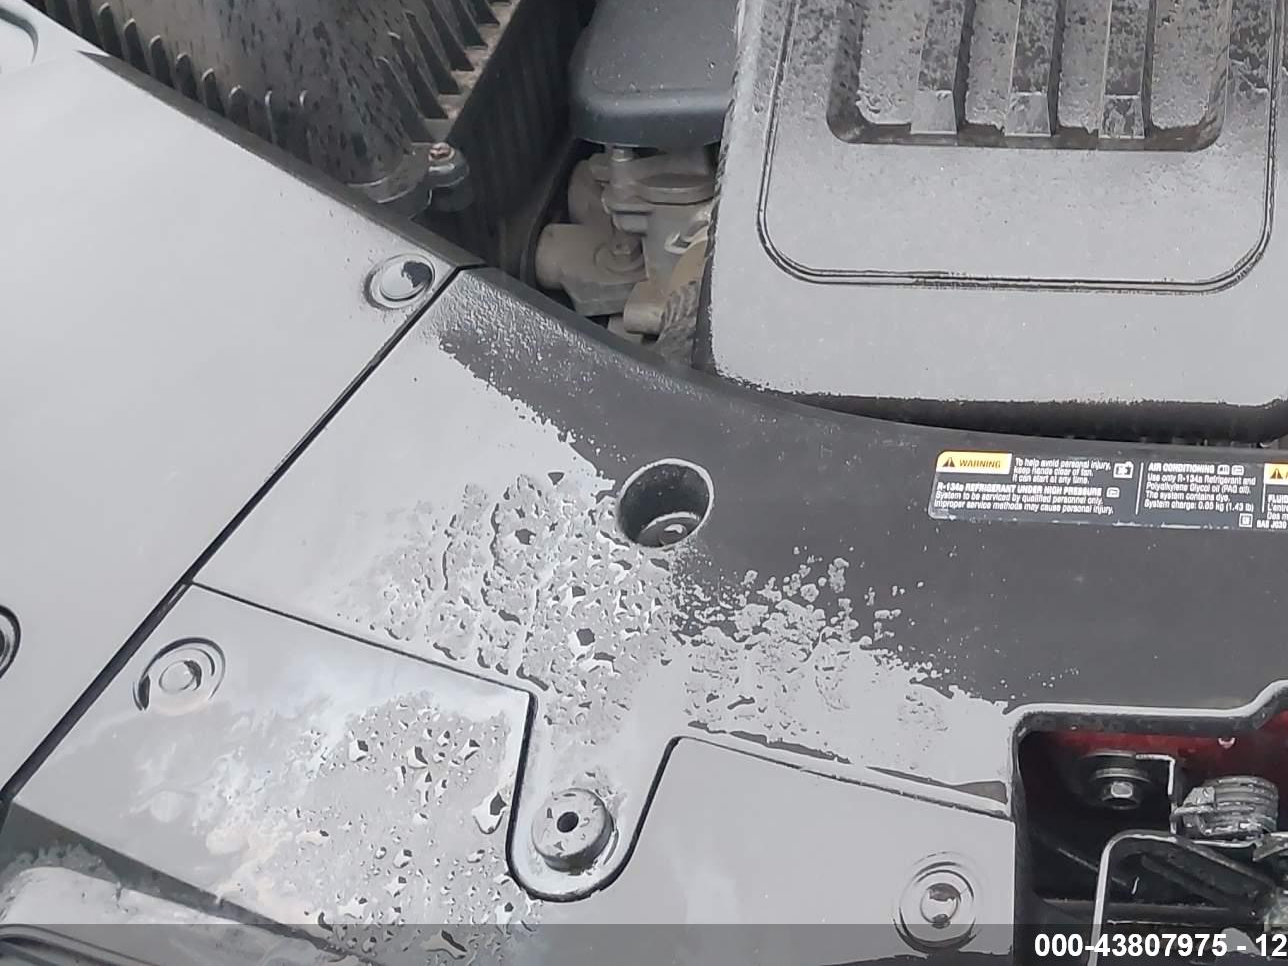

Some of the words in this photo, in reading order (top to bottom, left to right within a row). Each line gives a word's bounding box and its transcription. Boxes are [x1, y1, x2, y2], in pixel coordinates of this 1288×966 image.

[959, 459, 1000, 469] WARNING
[1148, 463, 1161, 472] AIR
[1163, 463, 1215, 473] CONDITIONING
[1147, 473, 1160, 481] Use
[1162, 474, 1176, 483] only
[1178, 475, 1202, 483] R-134a
[1204, 476, 1242, 485] Refrigerant
[1243, 477, 1256, 485] and
[1146, 490, 1158, 498] The
[1160, 492, 1184, 500] system
[1186, 492, 1214, 500] contains
[1216, 493, 1230, 502] dye.
